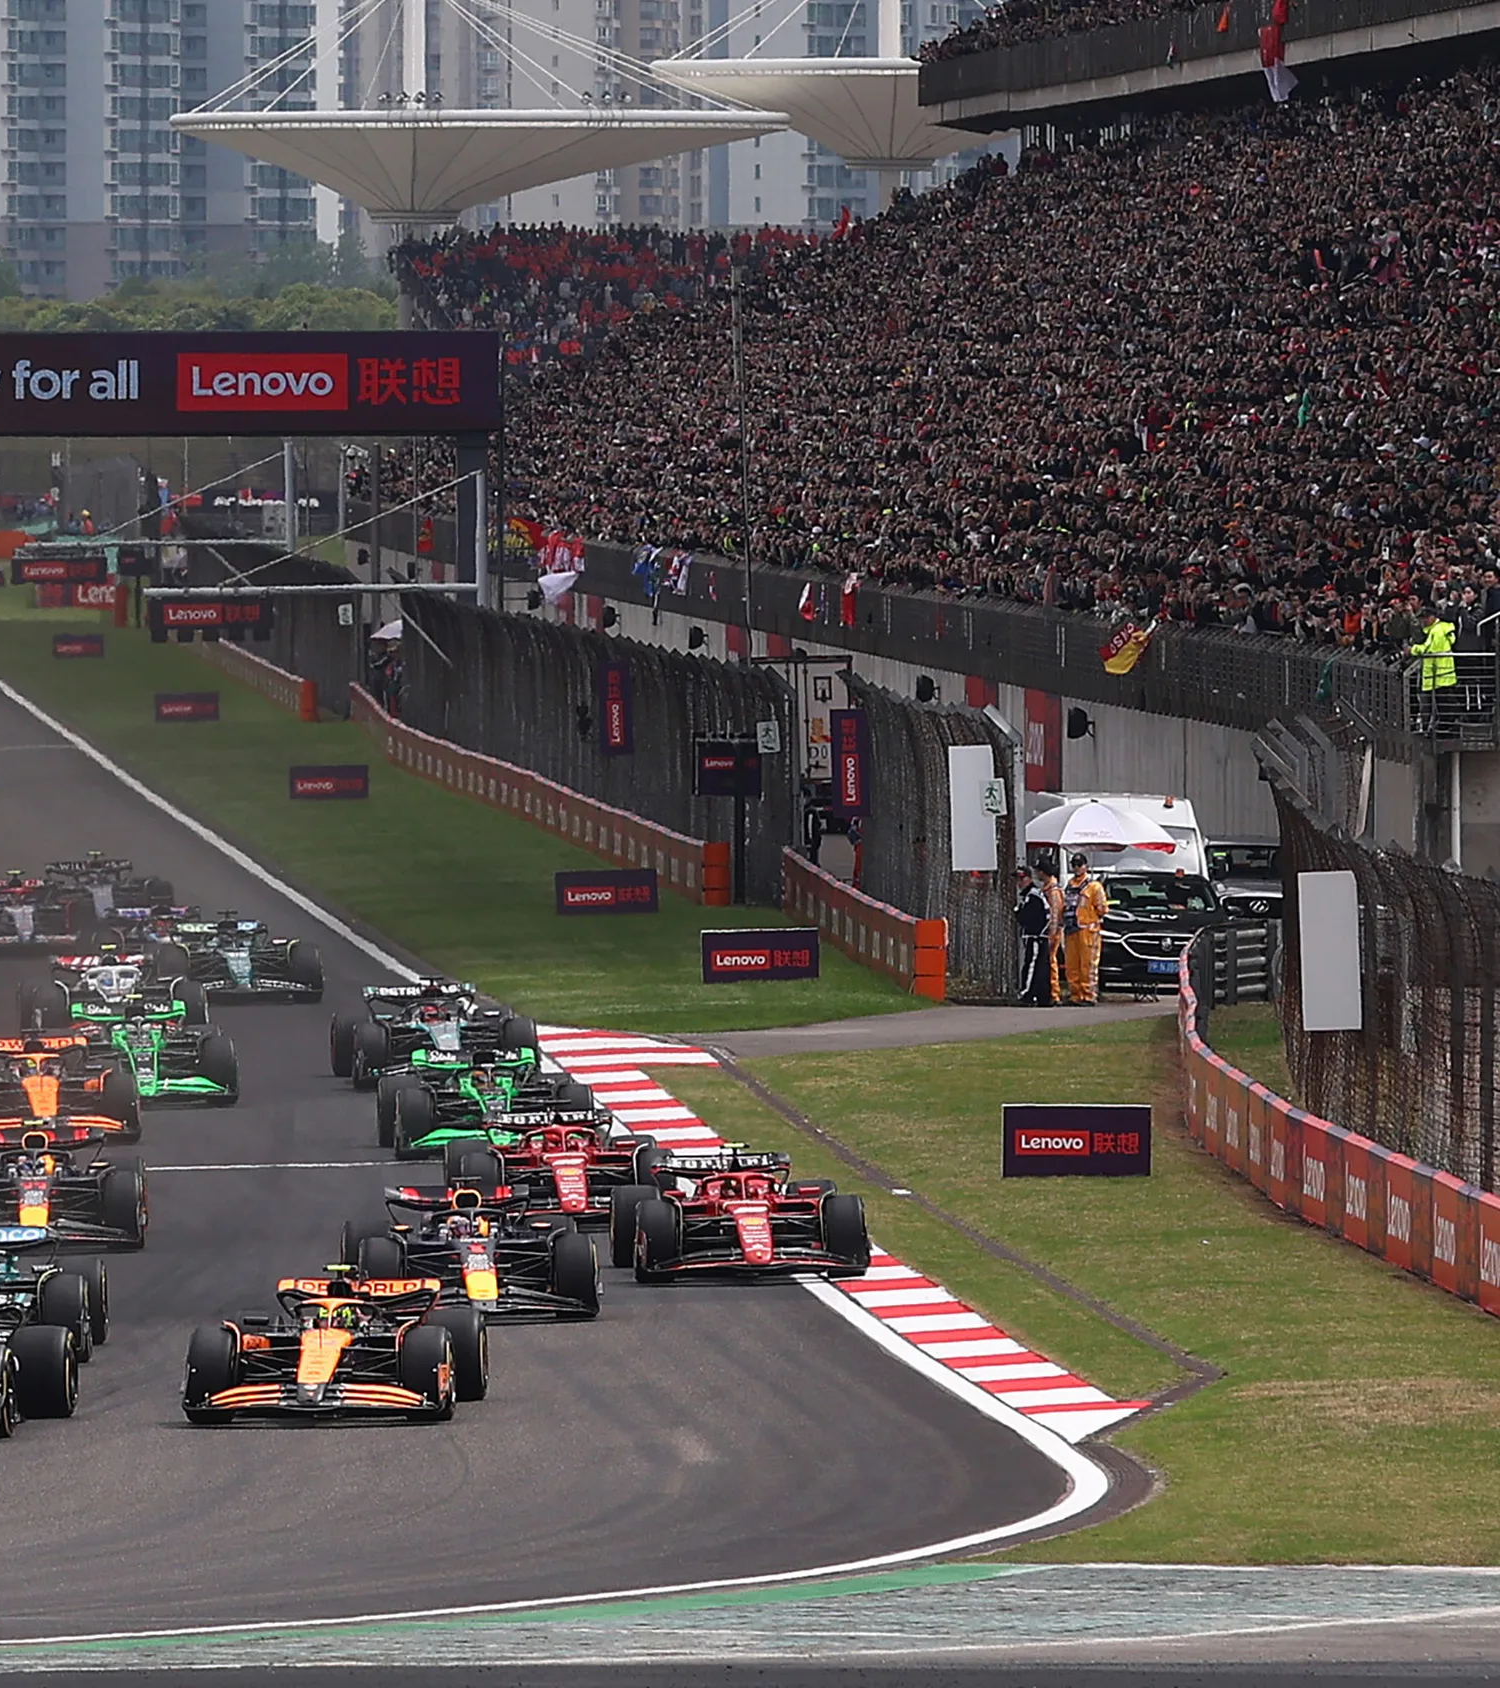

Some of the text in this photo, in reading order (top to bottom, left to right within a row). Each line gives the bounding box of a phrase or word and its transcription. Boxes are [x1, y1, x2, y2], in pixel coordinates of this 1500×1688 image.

[12, 359, 80, 400] for
[89, 359, 140, 400] all
[193, 365, 333, 396] Lenovo
[357, 357, 461, 405] 联想
[168, 609, 217, 621] Lenovo
[611, 704, 621, 742] Lenovo
[846, 757, 857, 802] Lenovo
[567, 890, 612, 902] Lenovo
[716, 953, 766, 966] Lenovo
[1021, 1133, 1140, 1154] Lenovo 联想
